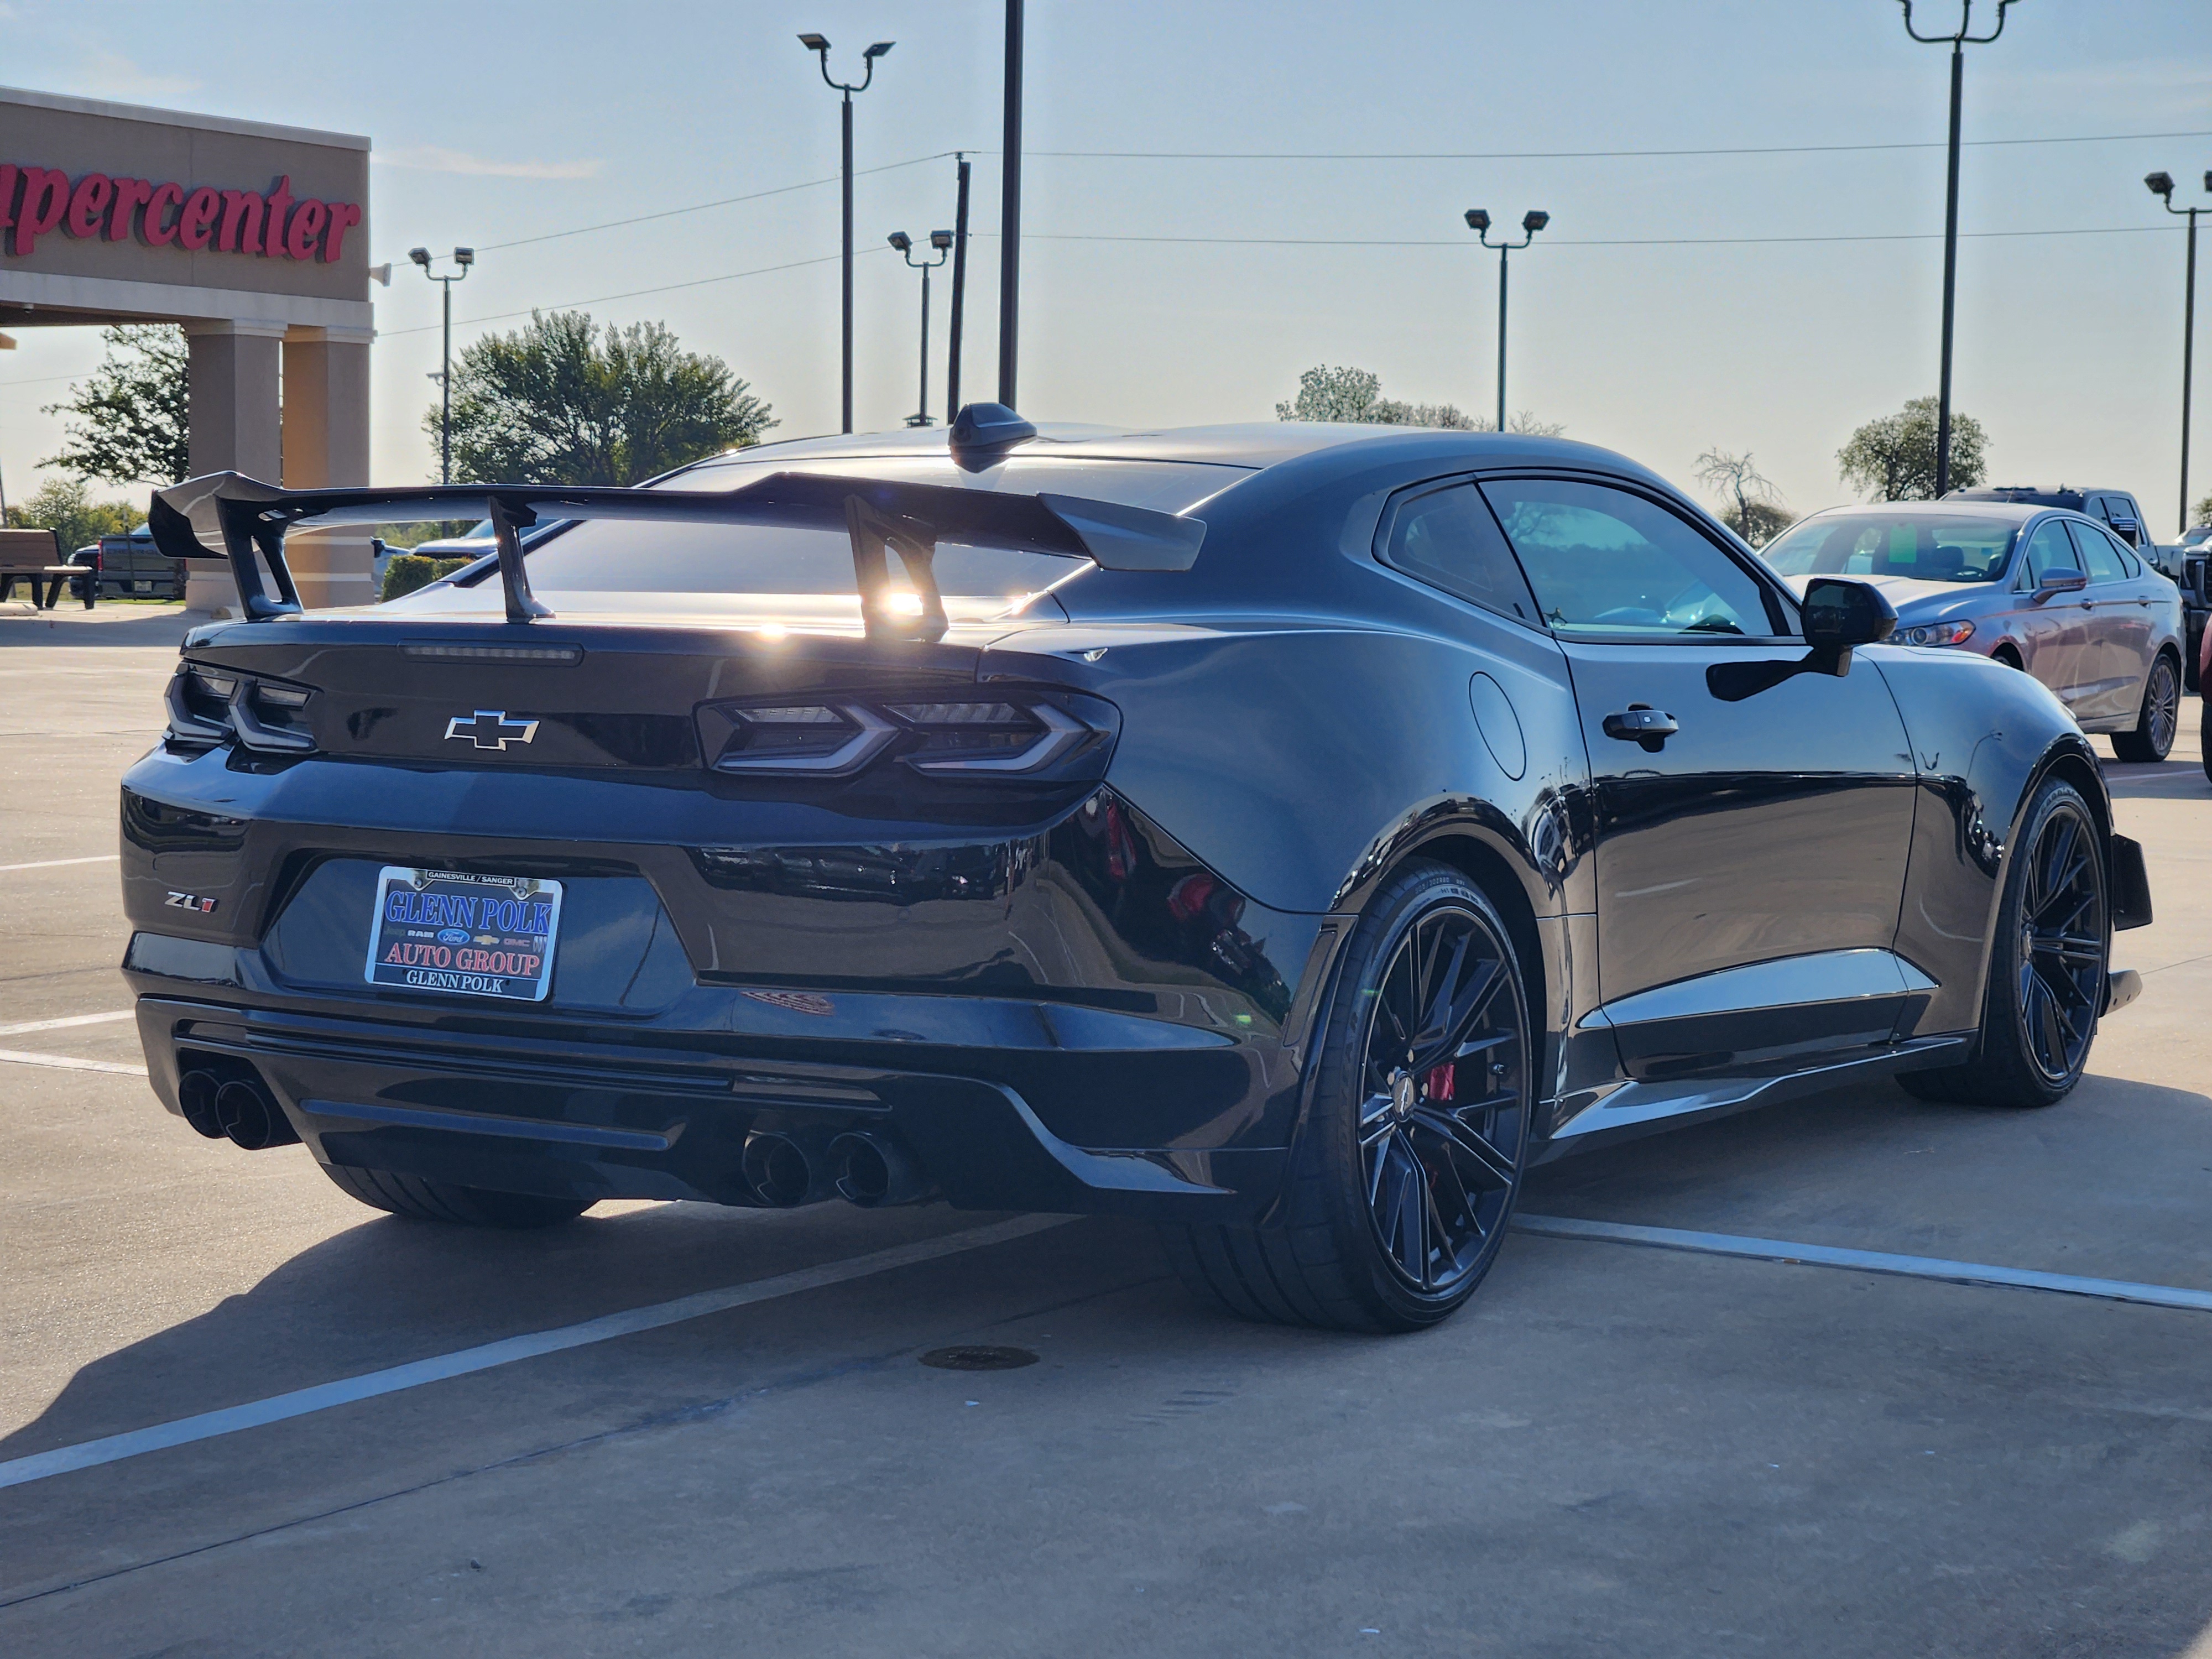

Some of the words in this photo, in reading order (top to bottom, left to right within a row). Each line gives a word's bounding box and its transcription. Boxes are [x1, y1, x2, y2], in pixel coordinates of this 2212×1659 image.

[428, 871, 476, 882] GAINESVILLE
[482, 876, 514, 885] SANGER
[165, 891, 216, 913] ZL1
[385, 890, 479, 928] GLENN
[479, 898, 552, 935] POLK
[408, 930, 435, 939] RAM
[443, 931, 464, 943] Ford
[503, 938, 530, 947] GMC
[384, 942, 451, 968] AUTO
[456, 948, 540, 976] GROUP
[406, 969, 458, 988] GLENN
[462, 975, 504, 993] POLK
